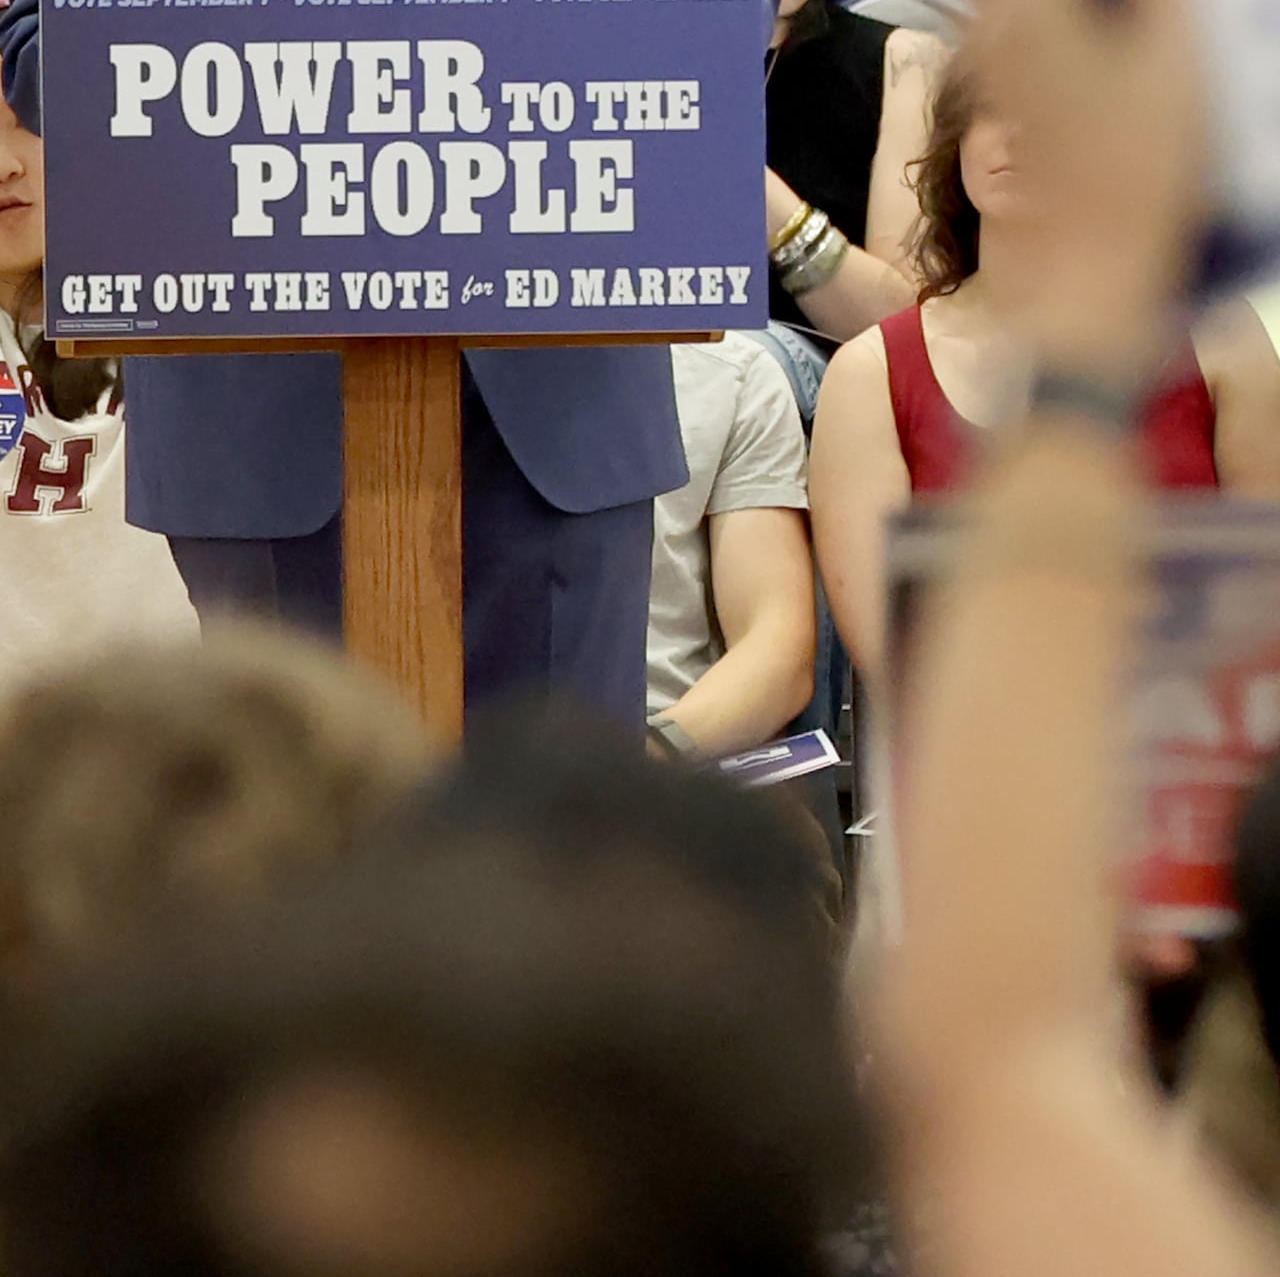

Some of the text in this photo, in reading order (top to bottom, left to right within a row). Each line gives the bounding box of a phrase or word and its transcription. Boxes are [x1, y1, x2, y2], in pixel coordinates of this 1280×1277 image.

[109, 39, 702, 138] POWER TO THE
[230, 138, 636, 238] PEOPLE
[60, 265, 752, 316] GET OUT THE VOTE for ED MARKEY
[4, 428, 98, 517] H
